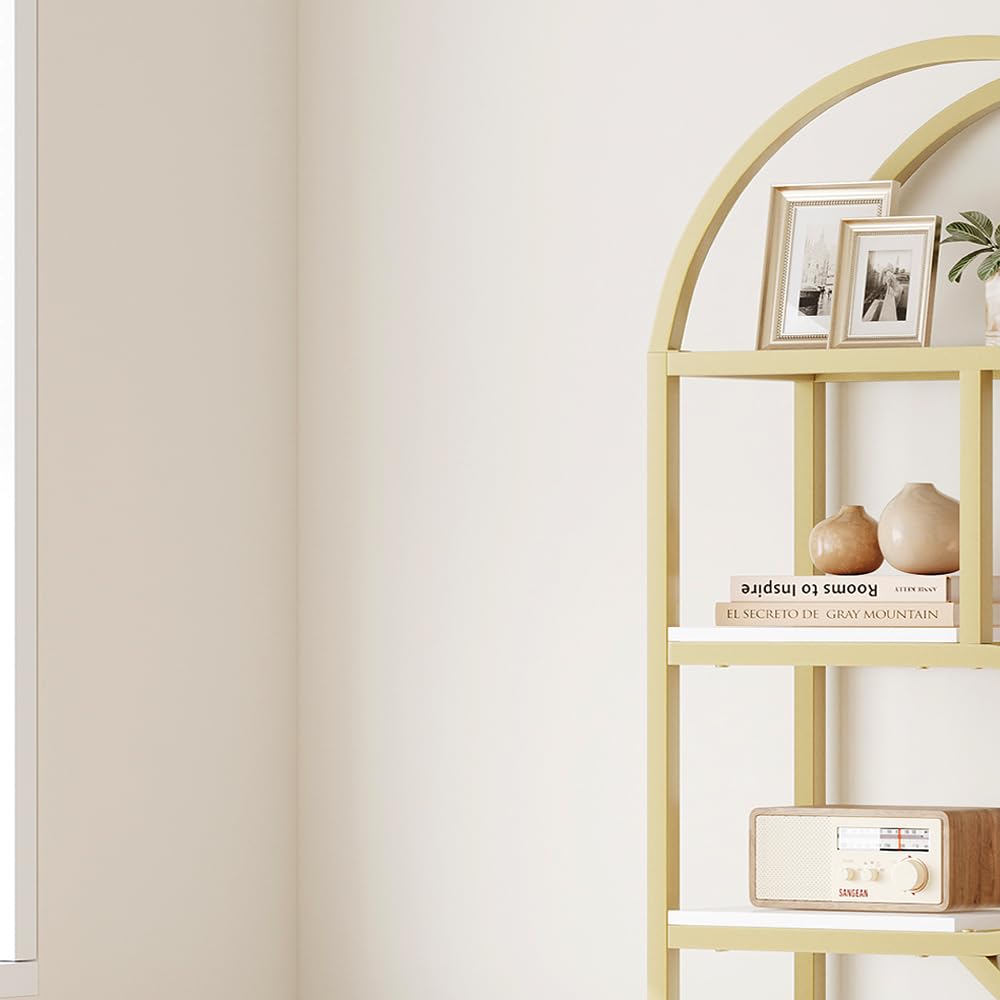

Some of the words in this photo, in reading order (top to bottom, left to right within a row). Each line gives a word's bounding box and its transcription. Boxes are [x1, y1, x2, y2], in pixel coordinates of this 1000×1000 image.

[741, 580, 796, 597] Inspire
[802, 584, 819, 596] to
[823, 583, 878, 597] Rooms
[727, 609, 741, 620] EL
[744, 608, 799, 620] SECRETO
[802, 609, 819, 620] DE
[826, 609, 861, 620] GRAY
[864, 609, 939, 620] MOUNTAIN
[838, 888, 869, 898] SANGEAN
